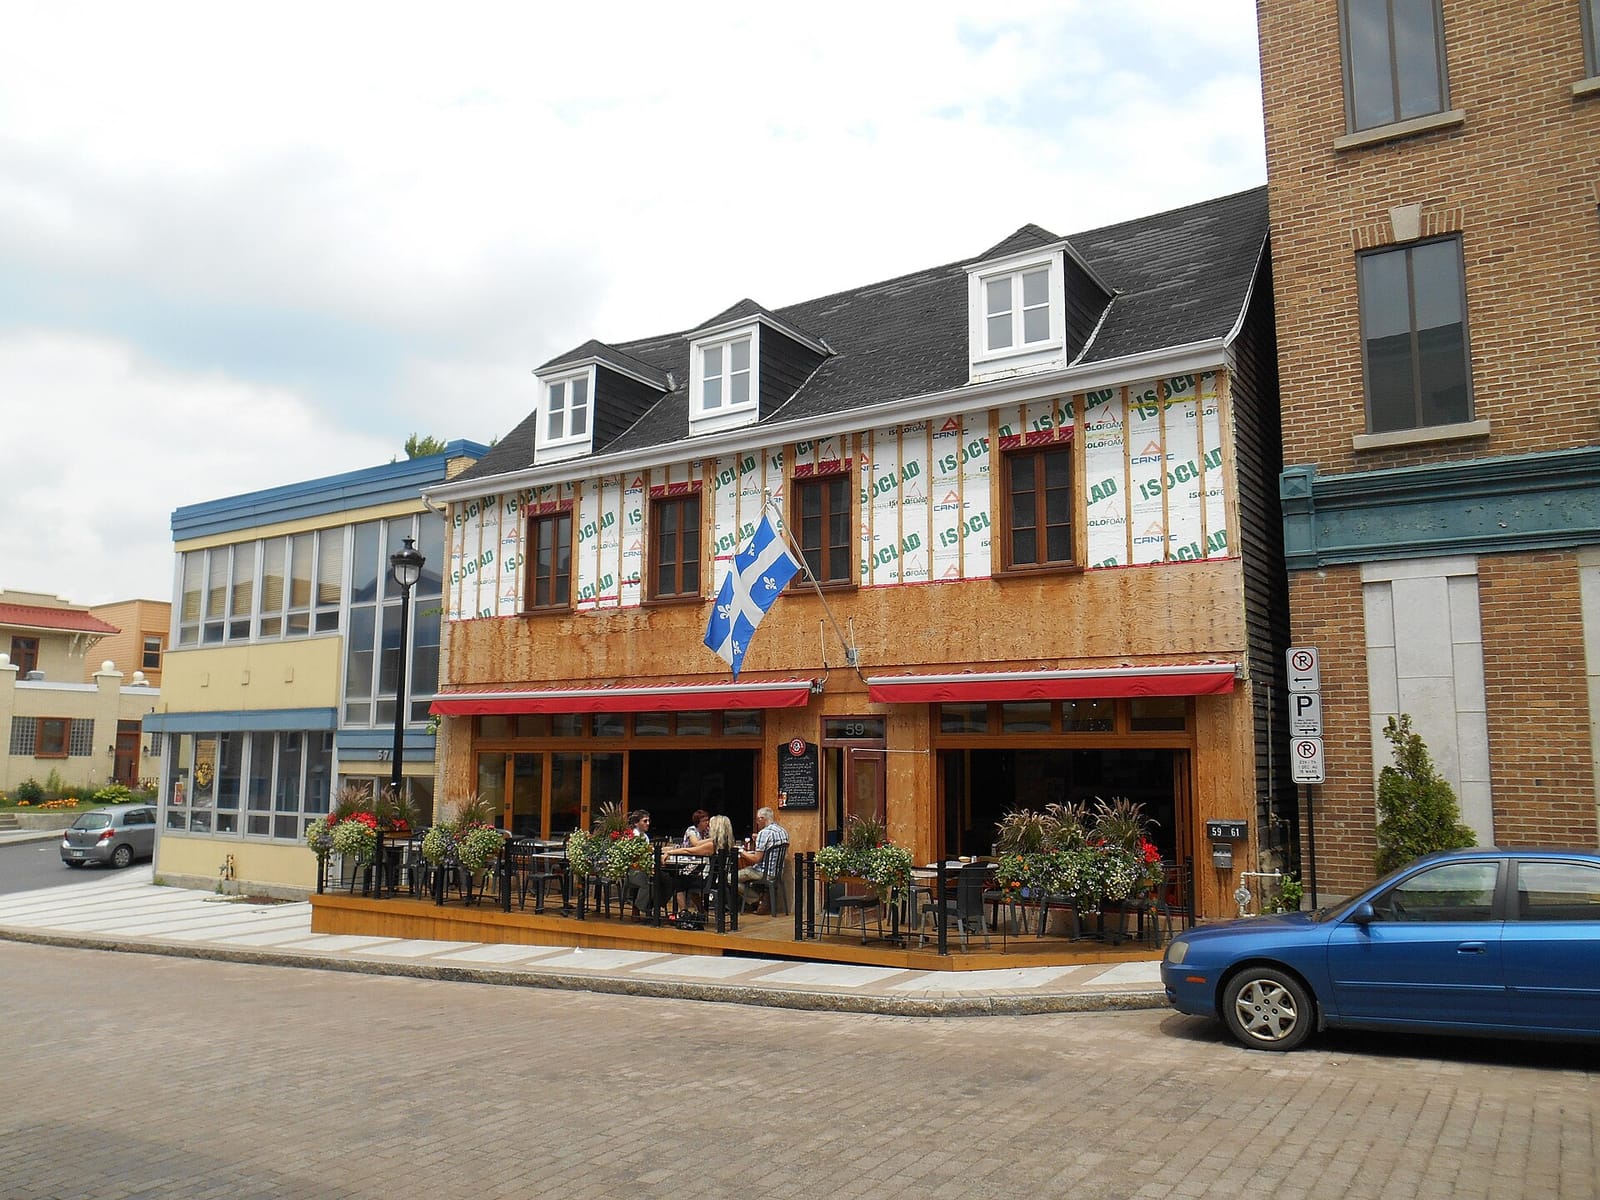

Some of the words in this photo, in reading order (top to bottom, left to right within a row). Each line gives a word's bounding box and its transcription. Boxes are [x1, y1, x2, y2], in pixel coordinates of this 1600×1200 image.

[1296, 695, 1313, 717] P
[846, 723, 864, 736] 59
[1211, 827, 1222, 837] 59
[1230, 827, 1240, 837] 61
